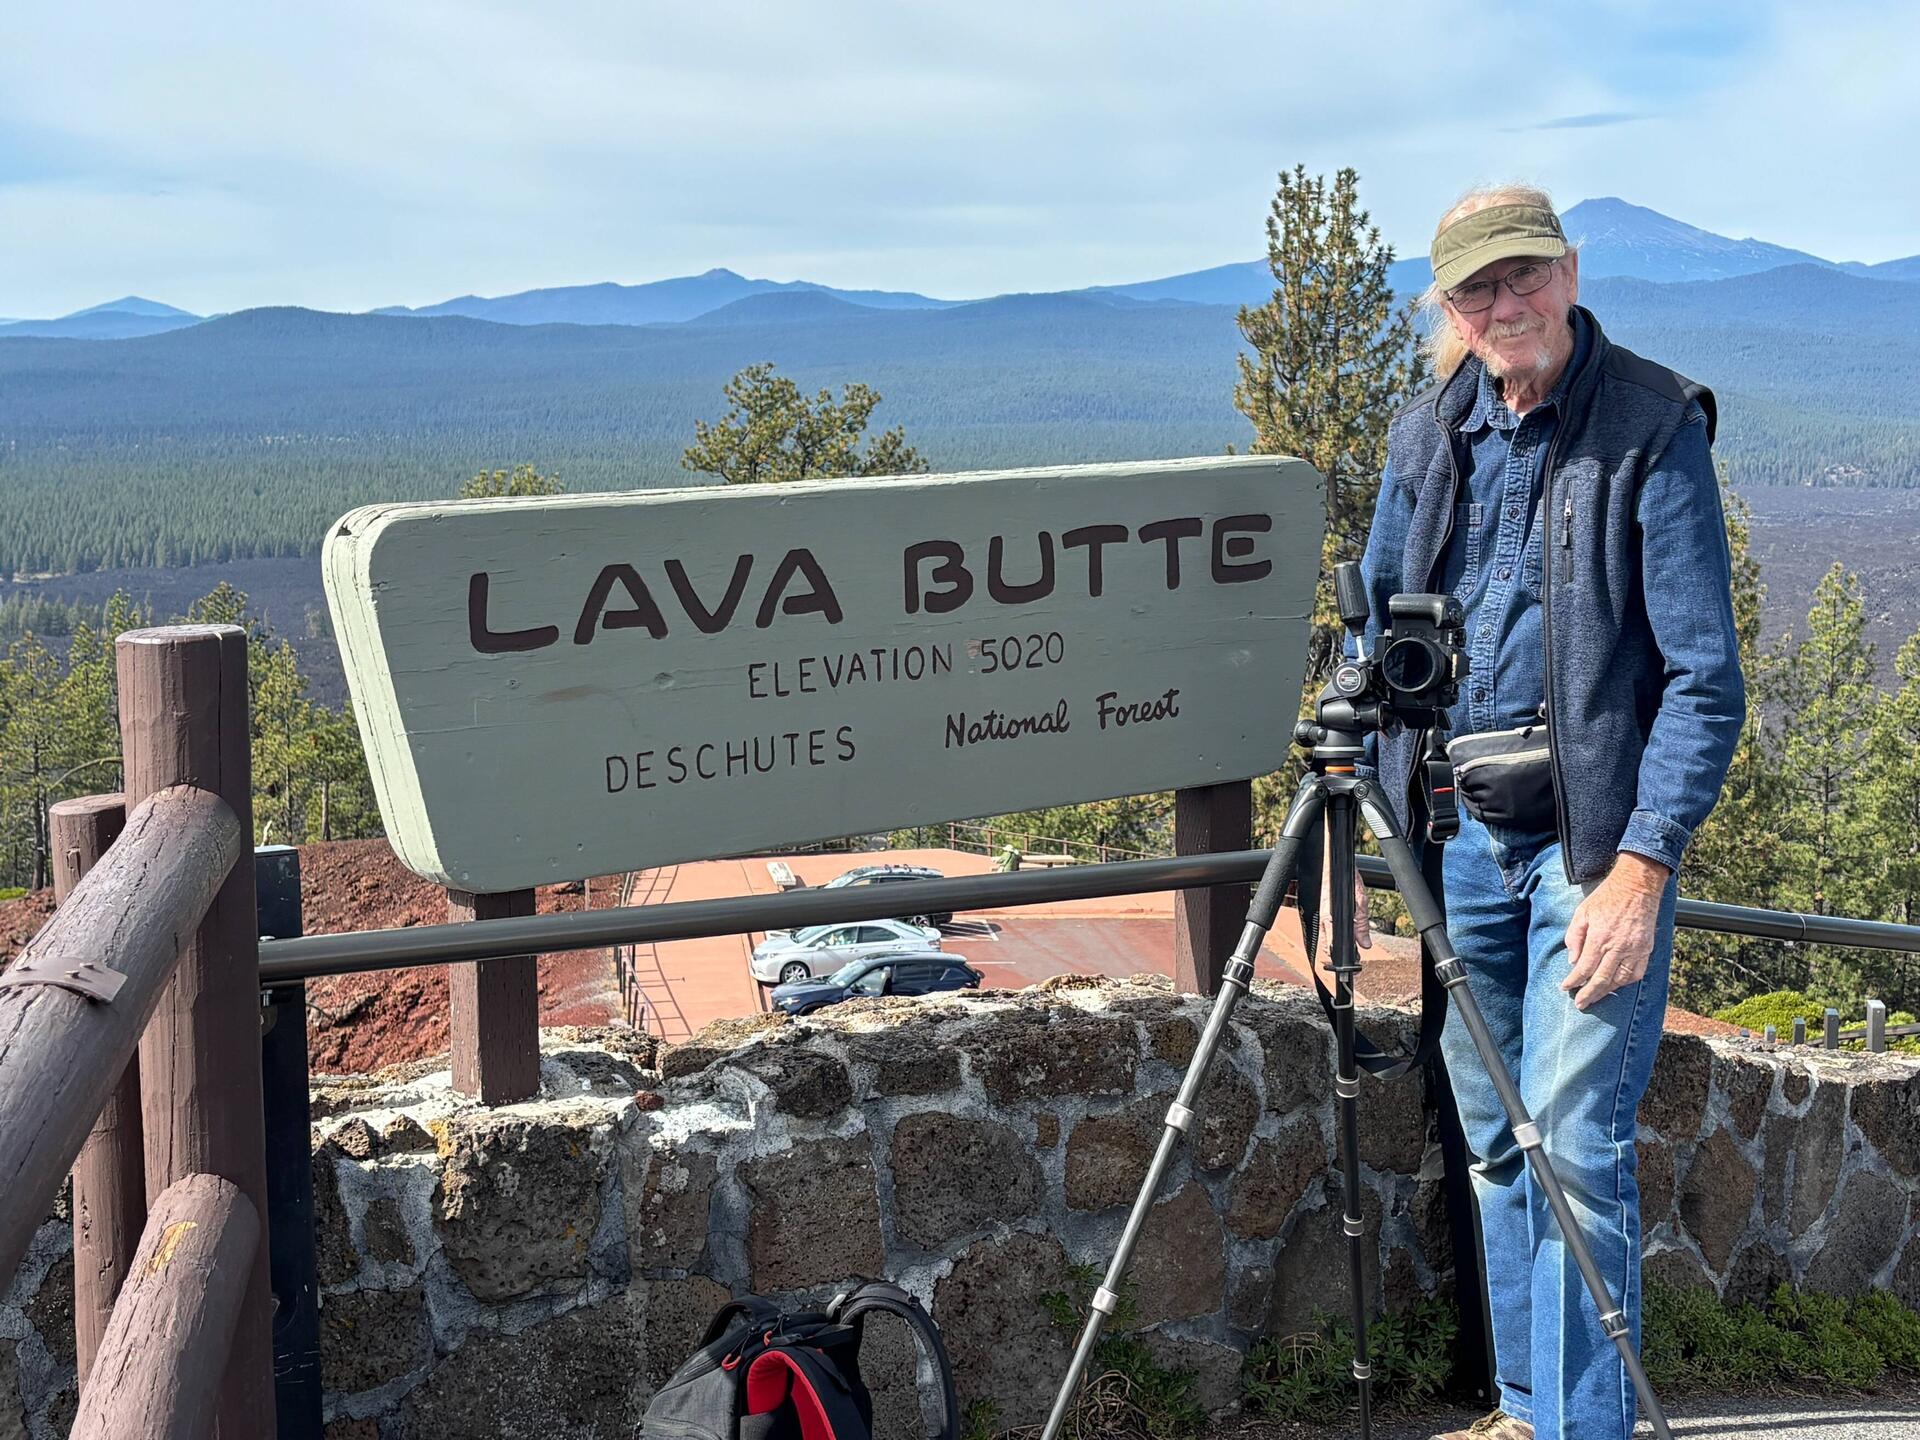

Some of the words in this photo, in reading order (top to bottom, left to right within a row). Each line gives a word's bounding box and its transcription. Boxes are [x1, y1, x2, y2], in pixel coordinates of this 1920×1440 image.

[468, 548, 844, 654] LAVA
[903, 513, 1273, 615] BUTTE
[747, 643, 952, 699] ELEVATION
[980, 631, 1064, 674] 5020
[606, 726, 856, 794] DESCHUTES
[945, 698, 1070, 749] National
[1096, 688, 1180, 730] Forest
